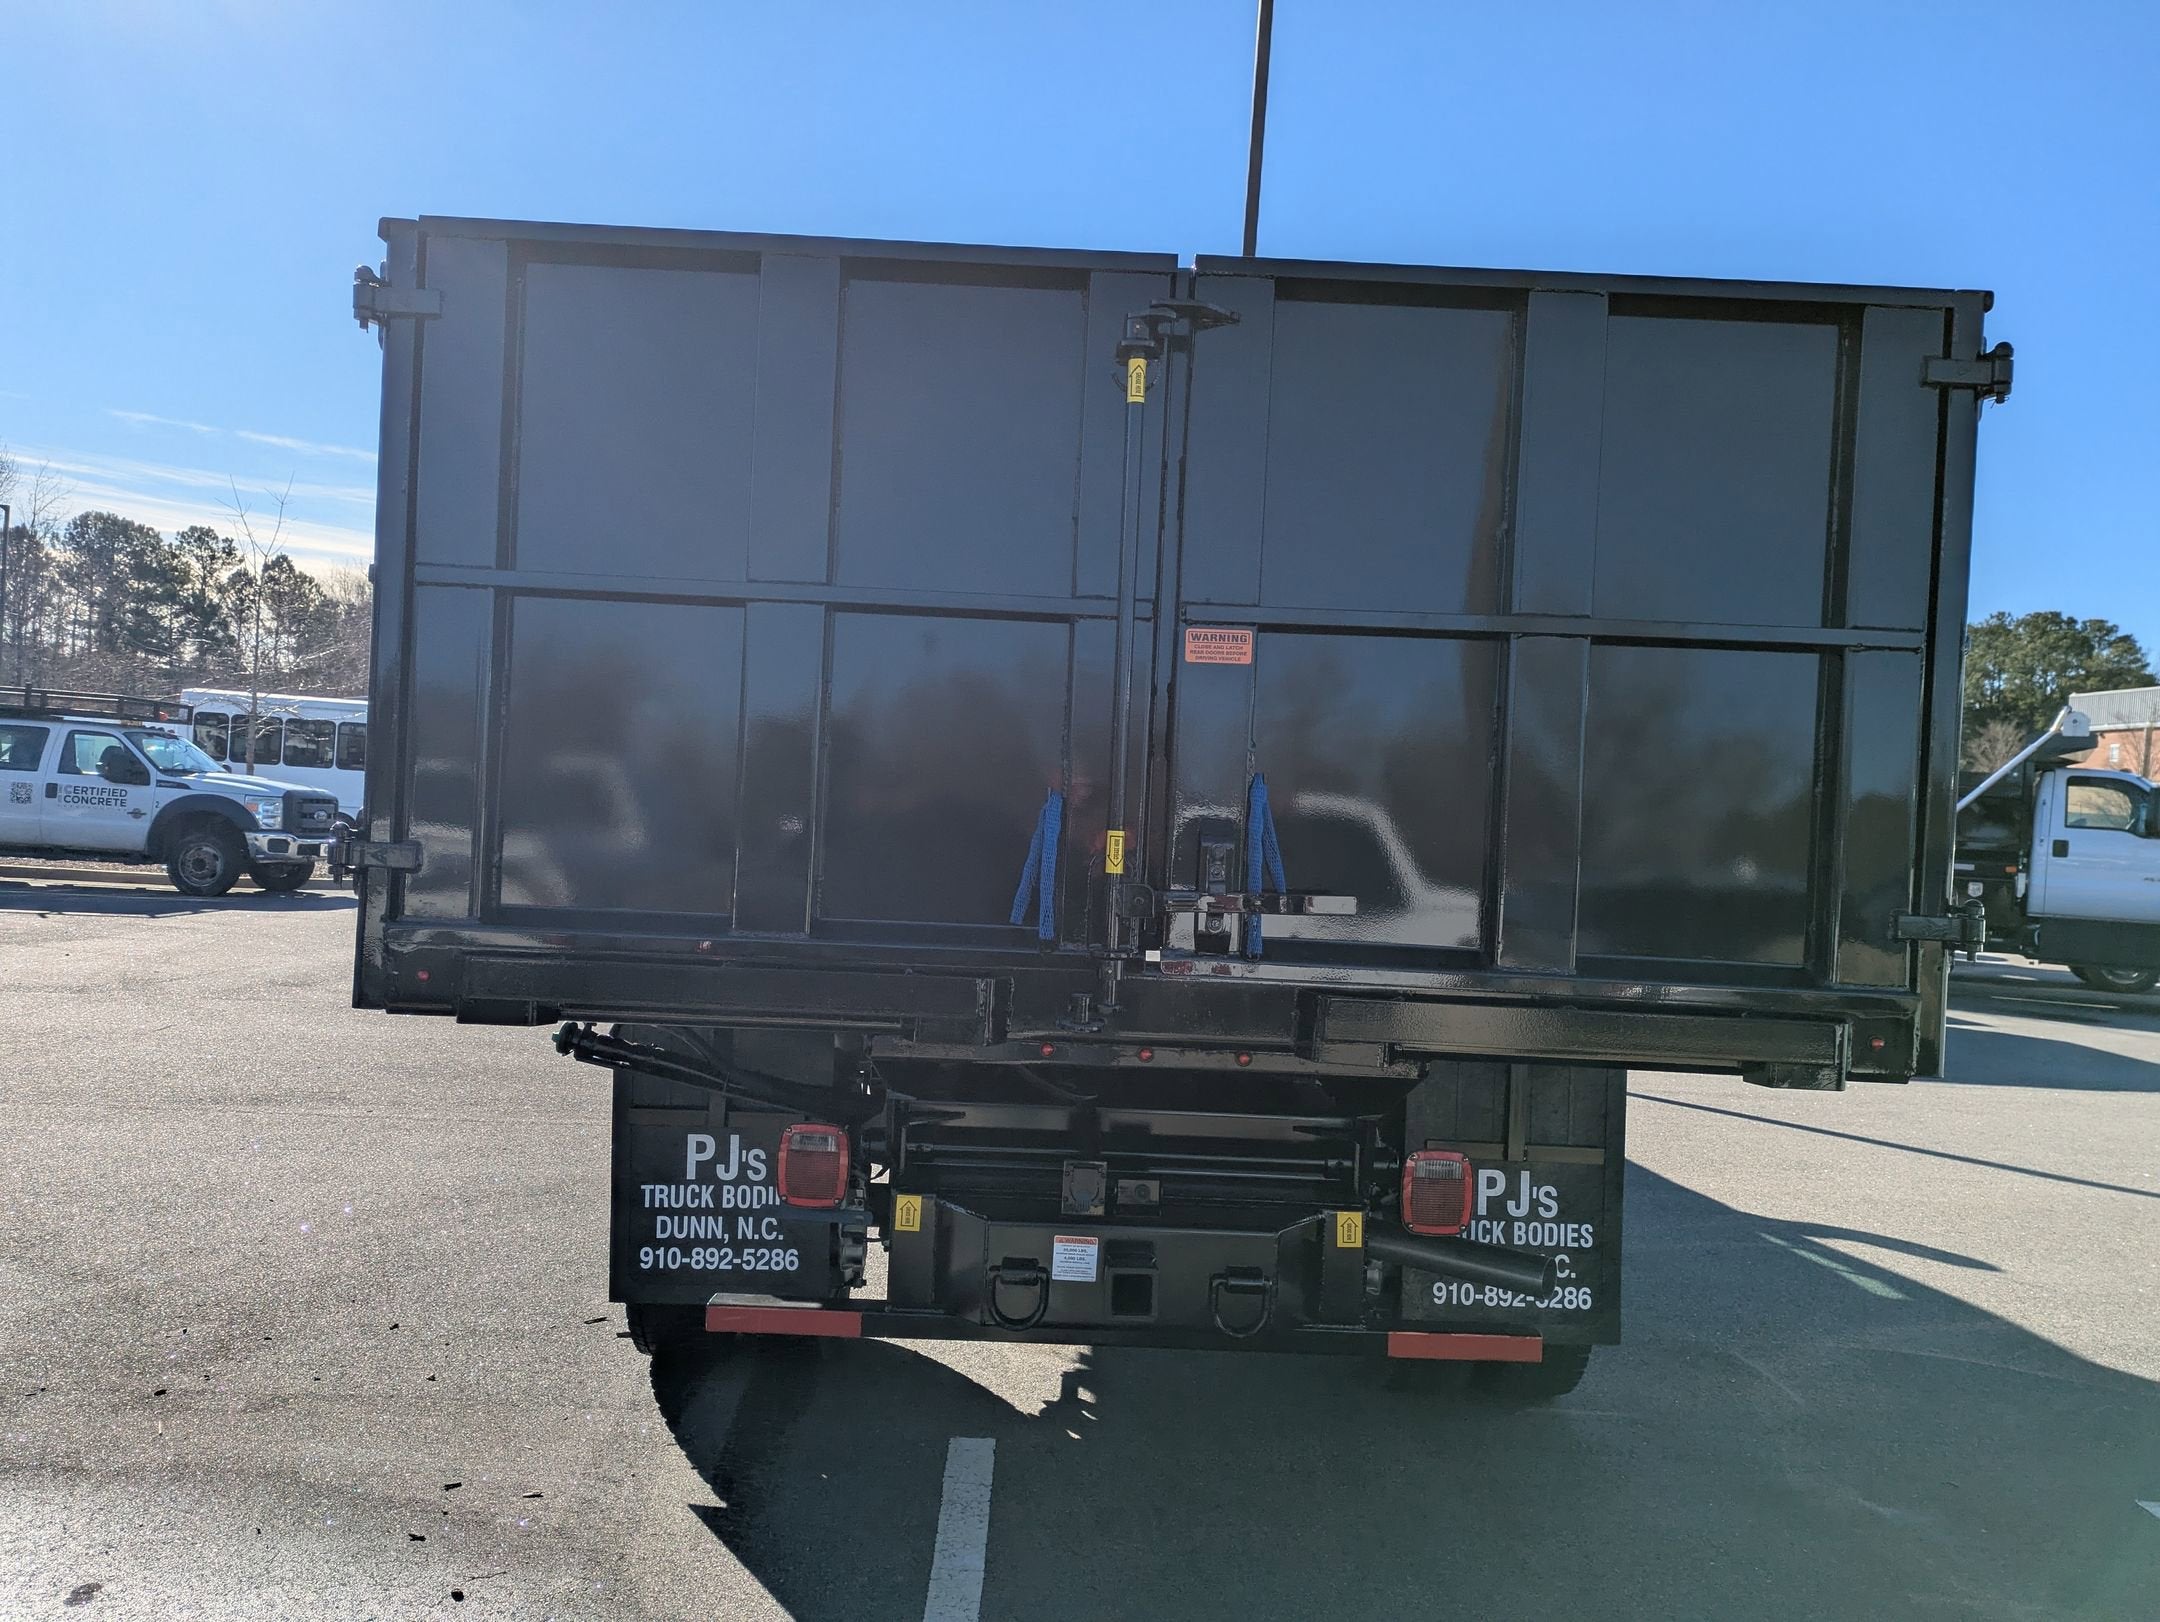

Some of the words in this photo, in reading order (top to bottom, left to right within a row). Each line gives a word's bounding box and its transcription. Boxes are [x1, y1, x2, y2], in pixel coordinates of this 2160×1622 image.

[1190, 633, 1247, 642] WARNING
[64, 784, 128, 797] CERTIFIED
[64, 795, 127, 807] CONCRETE
[641, 1185, 715, 1208] TRUCK
[722, 1185, 782, 1209] BODI
[656, 1216, 730, 1243] DUNN,
[737, 1217, 784, 1241] N.C.
[1513, 1222, 1594, 1248] BODIES
[639, 1247, 799, 1271] 910-892-5286
